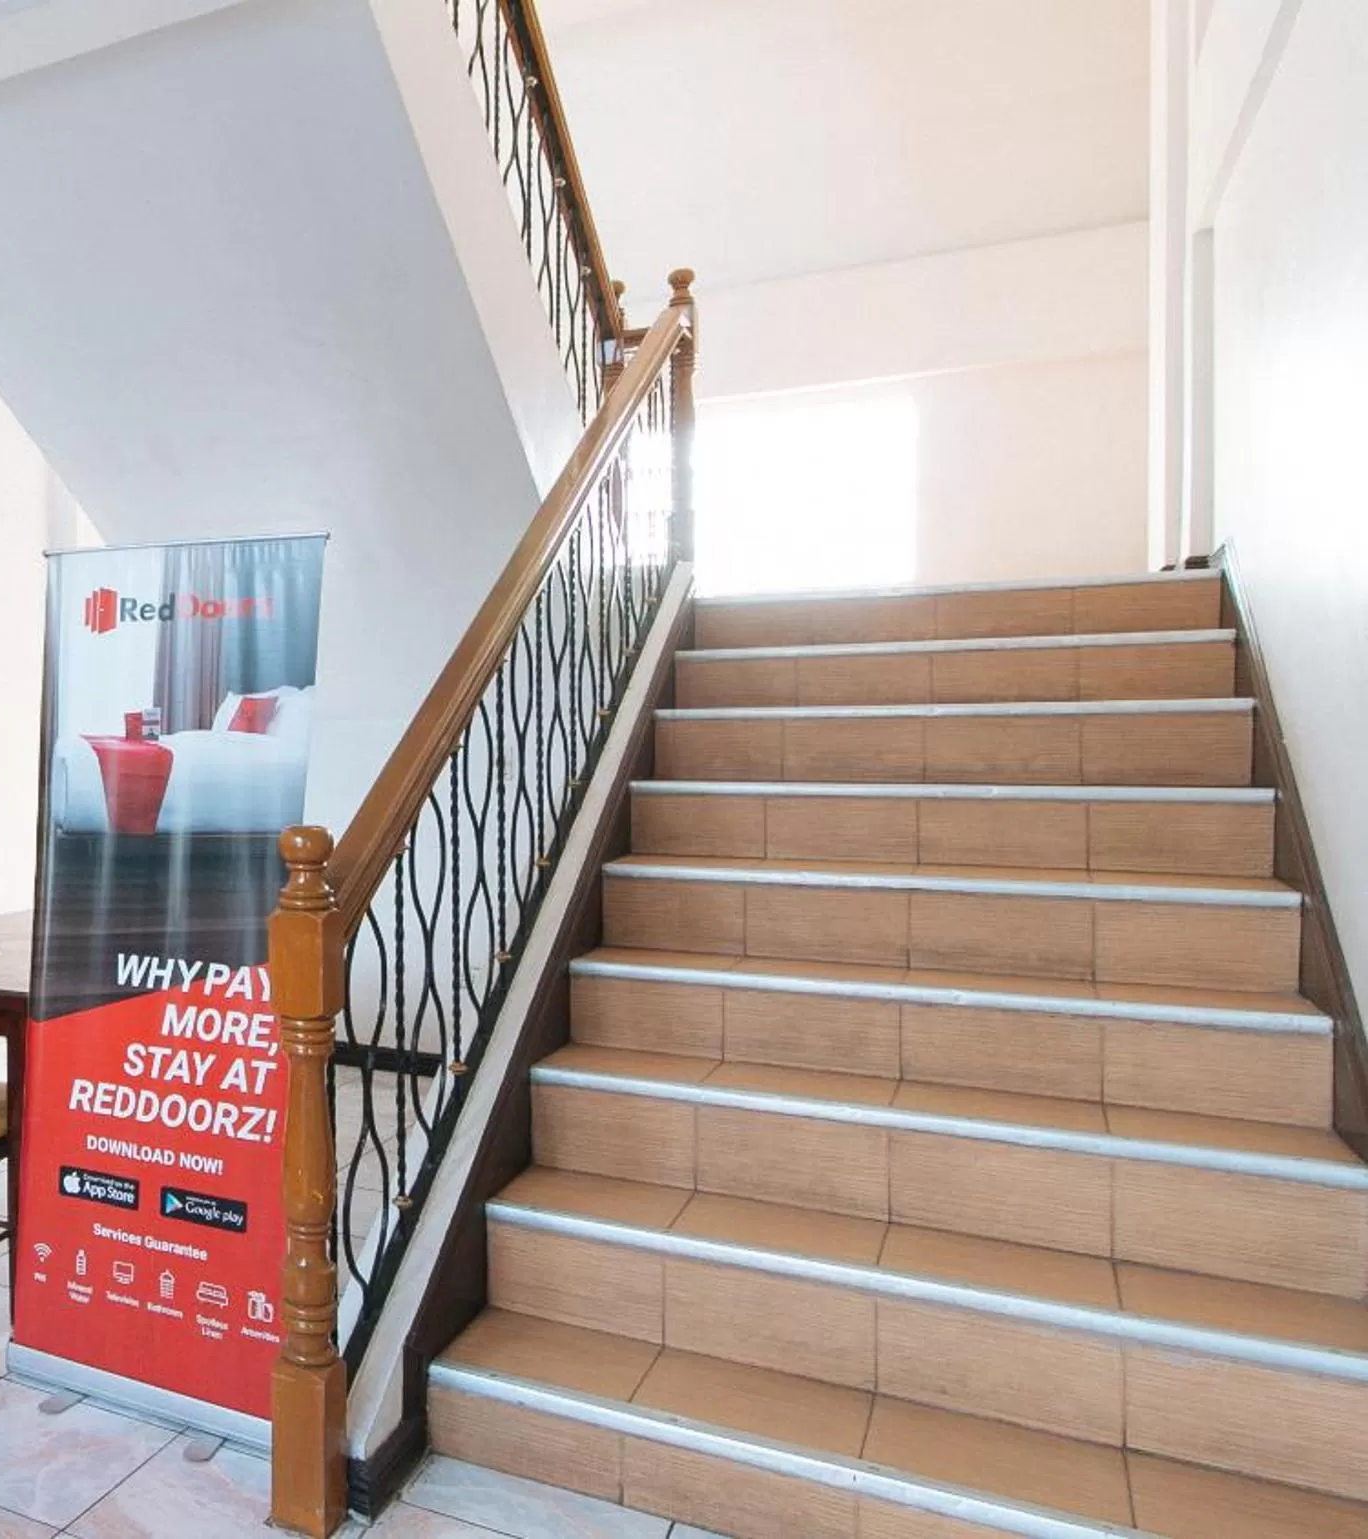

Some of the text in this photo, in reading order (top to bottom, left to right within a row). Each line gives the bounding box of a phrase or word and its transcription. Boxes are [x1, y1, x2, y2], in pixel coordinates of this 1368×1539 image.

[116, 953, 271, 1002] WHY PAY
[161, 1003, 279, 1057] MORE,
[123, 1043, 277, 1095] STAY AT
[68, 1079, 277, 1143] REDDOORZ!
[86, 1134, 224, 1176] DOWNLOAD NOW!
[82, 1181, 135, 1204] App Store
[185, 1201, 243, 1227] Google play
[93, 1222, 208, 1261] Services Guarantee
